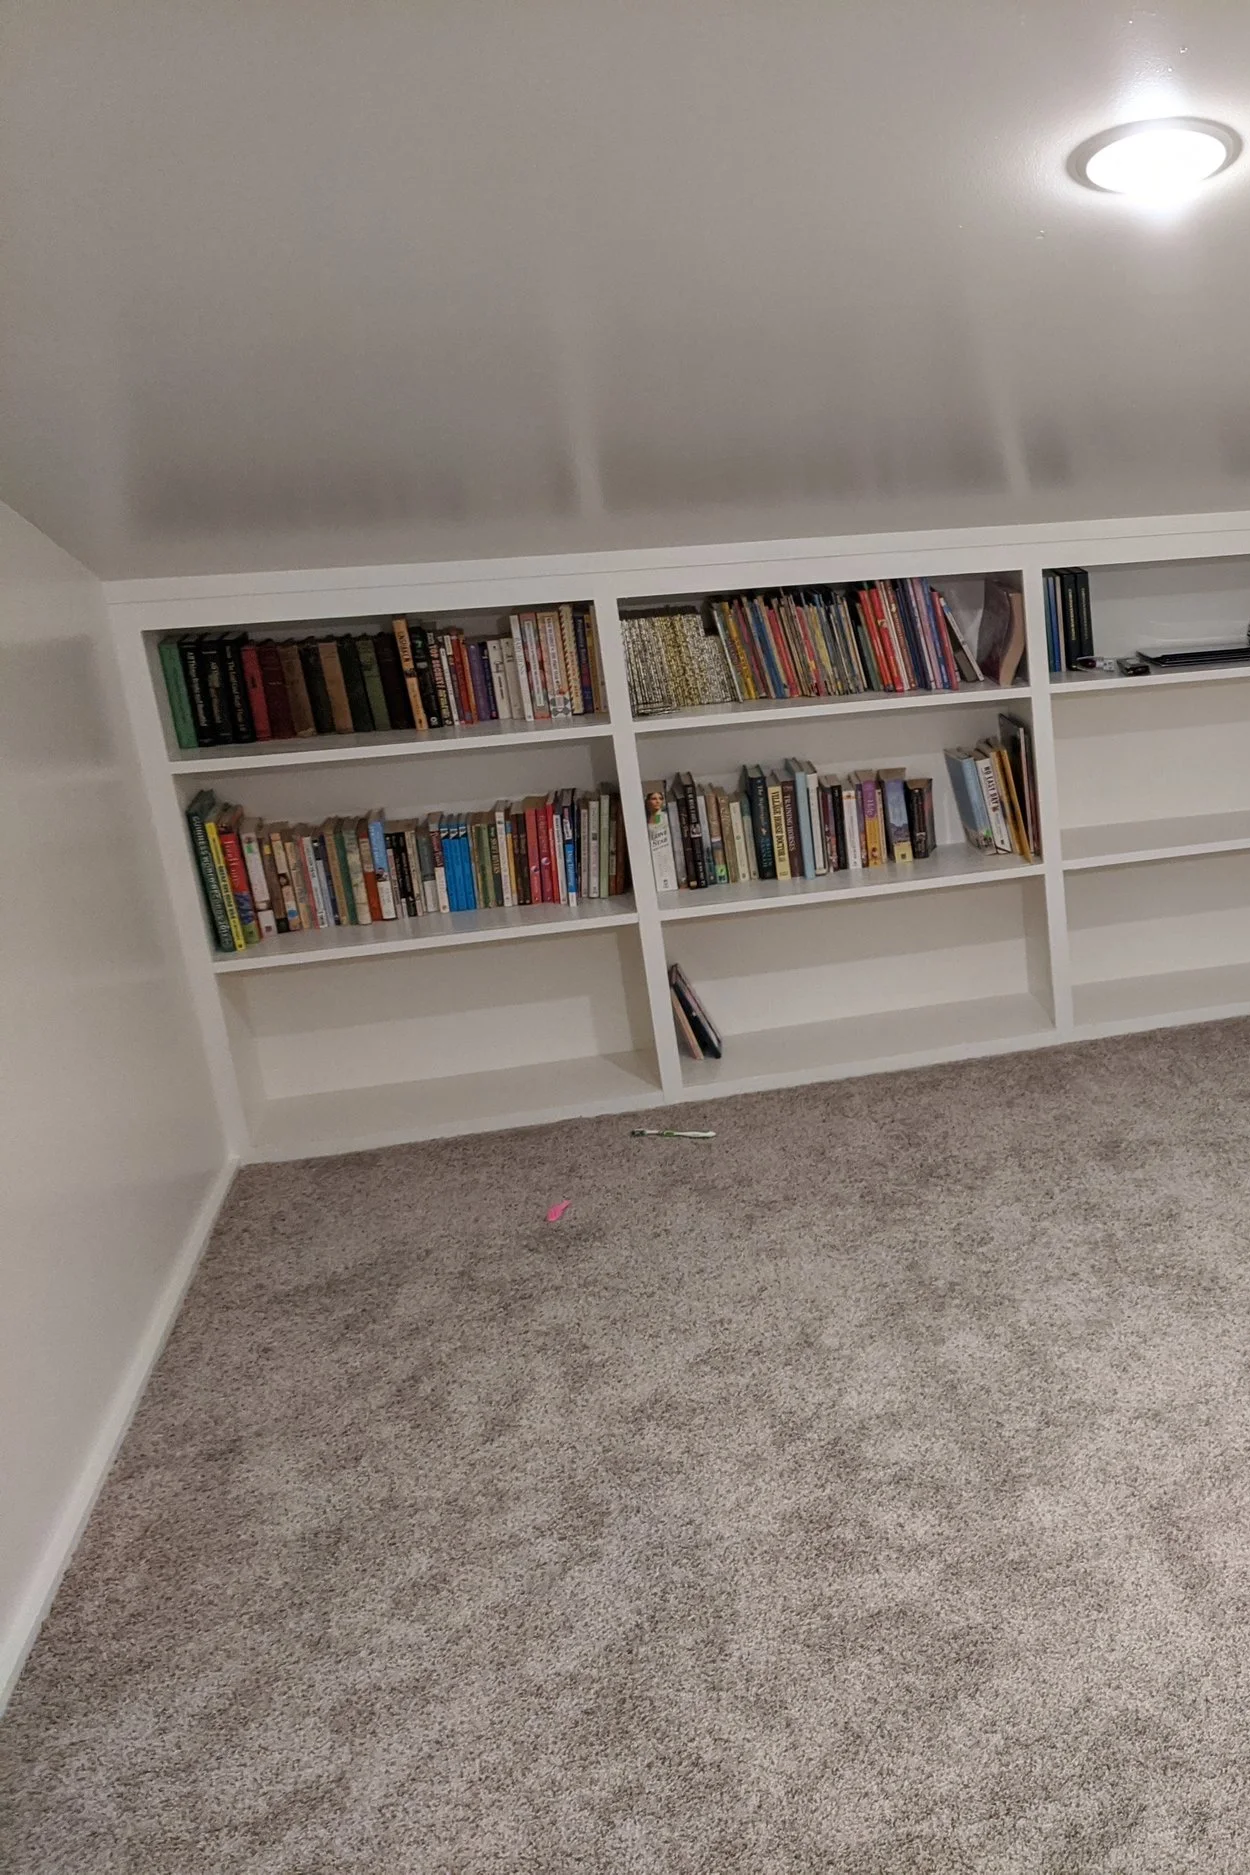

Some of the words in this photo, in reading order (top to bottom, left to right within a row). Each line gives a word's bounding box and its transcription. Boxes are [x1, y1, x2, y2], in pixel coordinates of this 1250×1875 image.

[429, 644, 439, 658] TOP
[985, 775, 995, 791] EASY
[990, 792, 999, 804] DAY
[771, 791, 781, 815] VILLAGE
[784, 794, 793, 825] TRAINING
[191, 816, 208, 855] GUINNESS
[773, 815, 783, 834] HORSE
[775, 834, 785, 856] DOCTOR
[787, 826, 796, 851] HORSES
